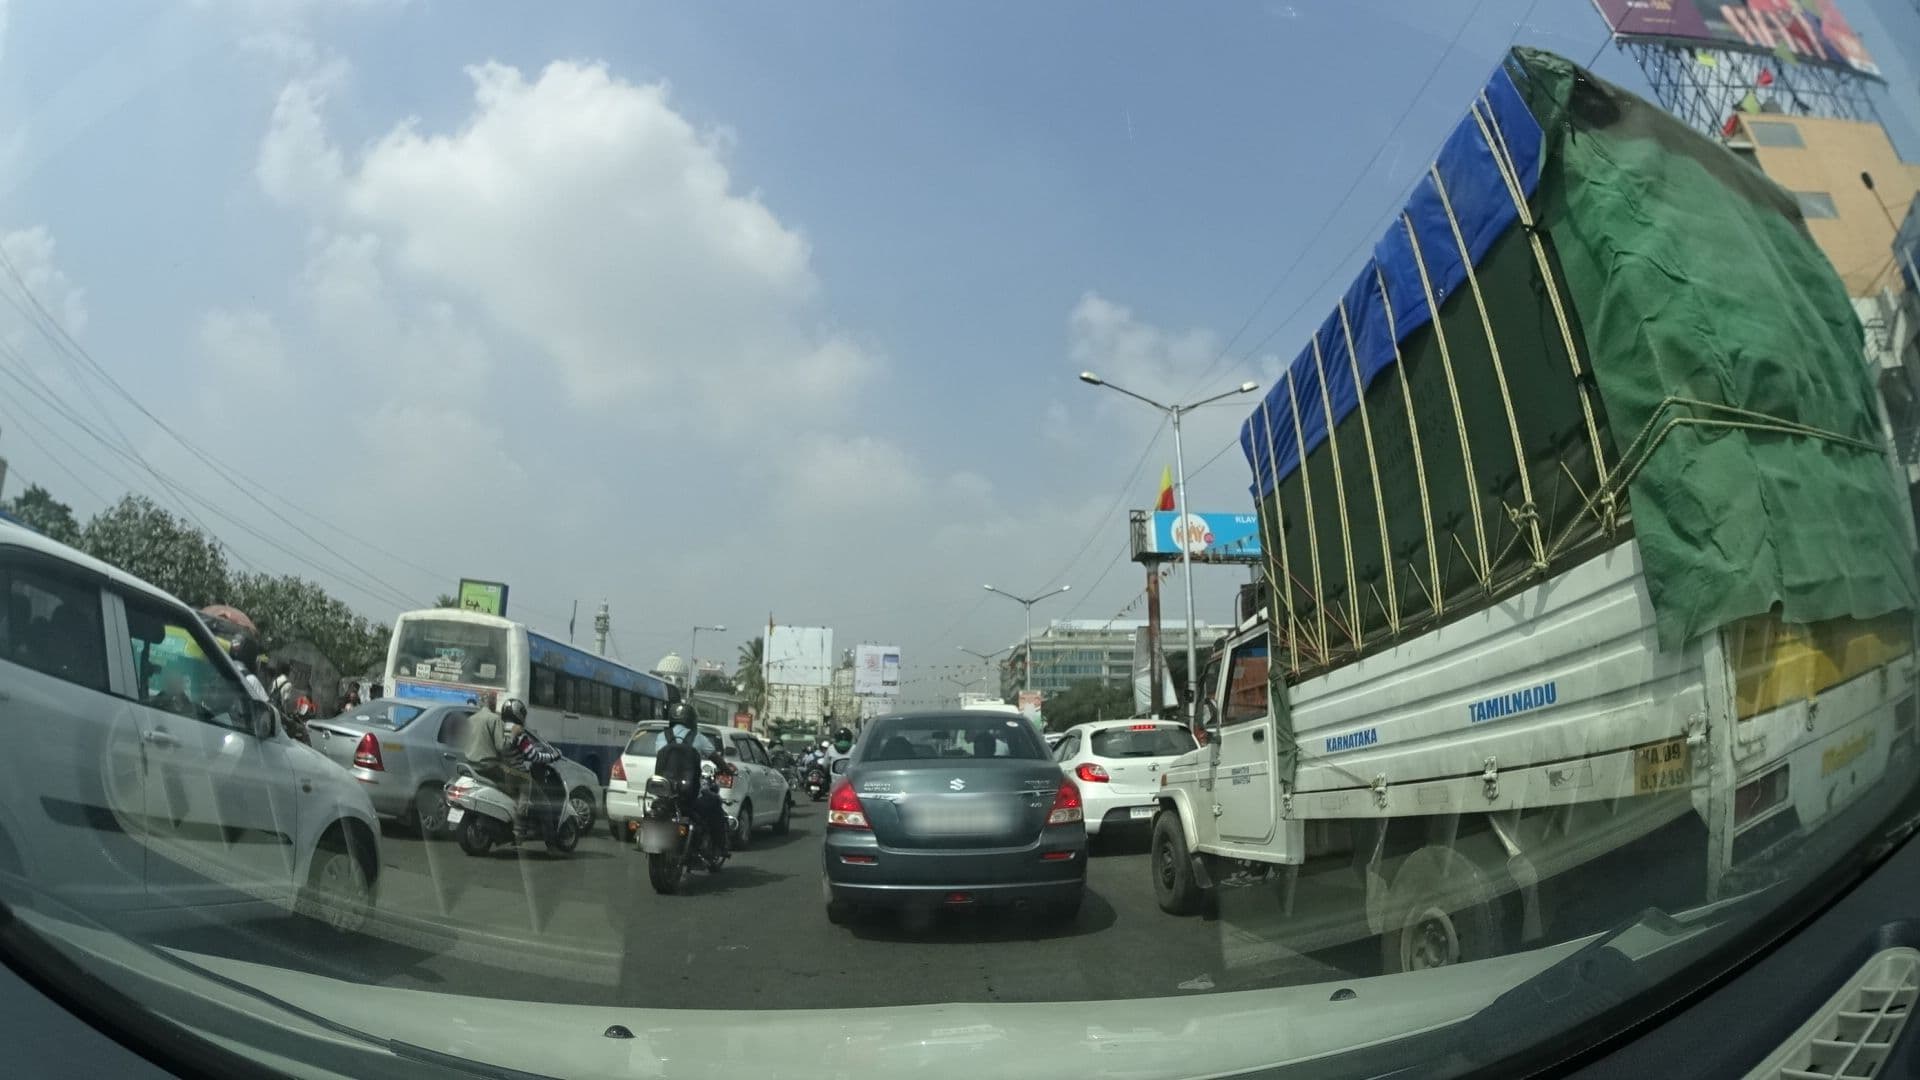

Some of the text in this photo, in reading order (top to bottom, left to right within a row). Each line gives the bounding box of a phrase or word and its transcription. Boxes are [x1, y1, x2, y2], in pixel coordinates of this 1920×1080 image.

[1175, 525, 1205, 543] KAY
[1468, 682, 1557, 722] TAMILNADU
[1326, 728, 1377, 752] KARNATAKA
